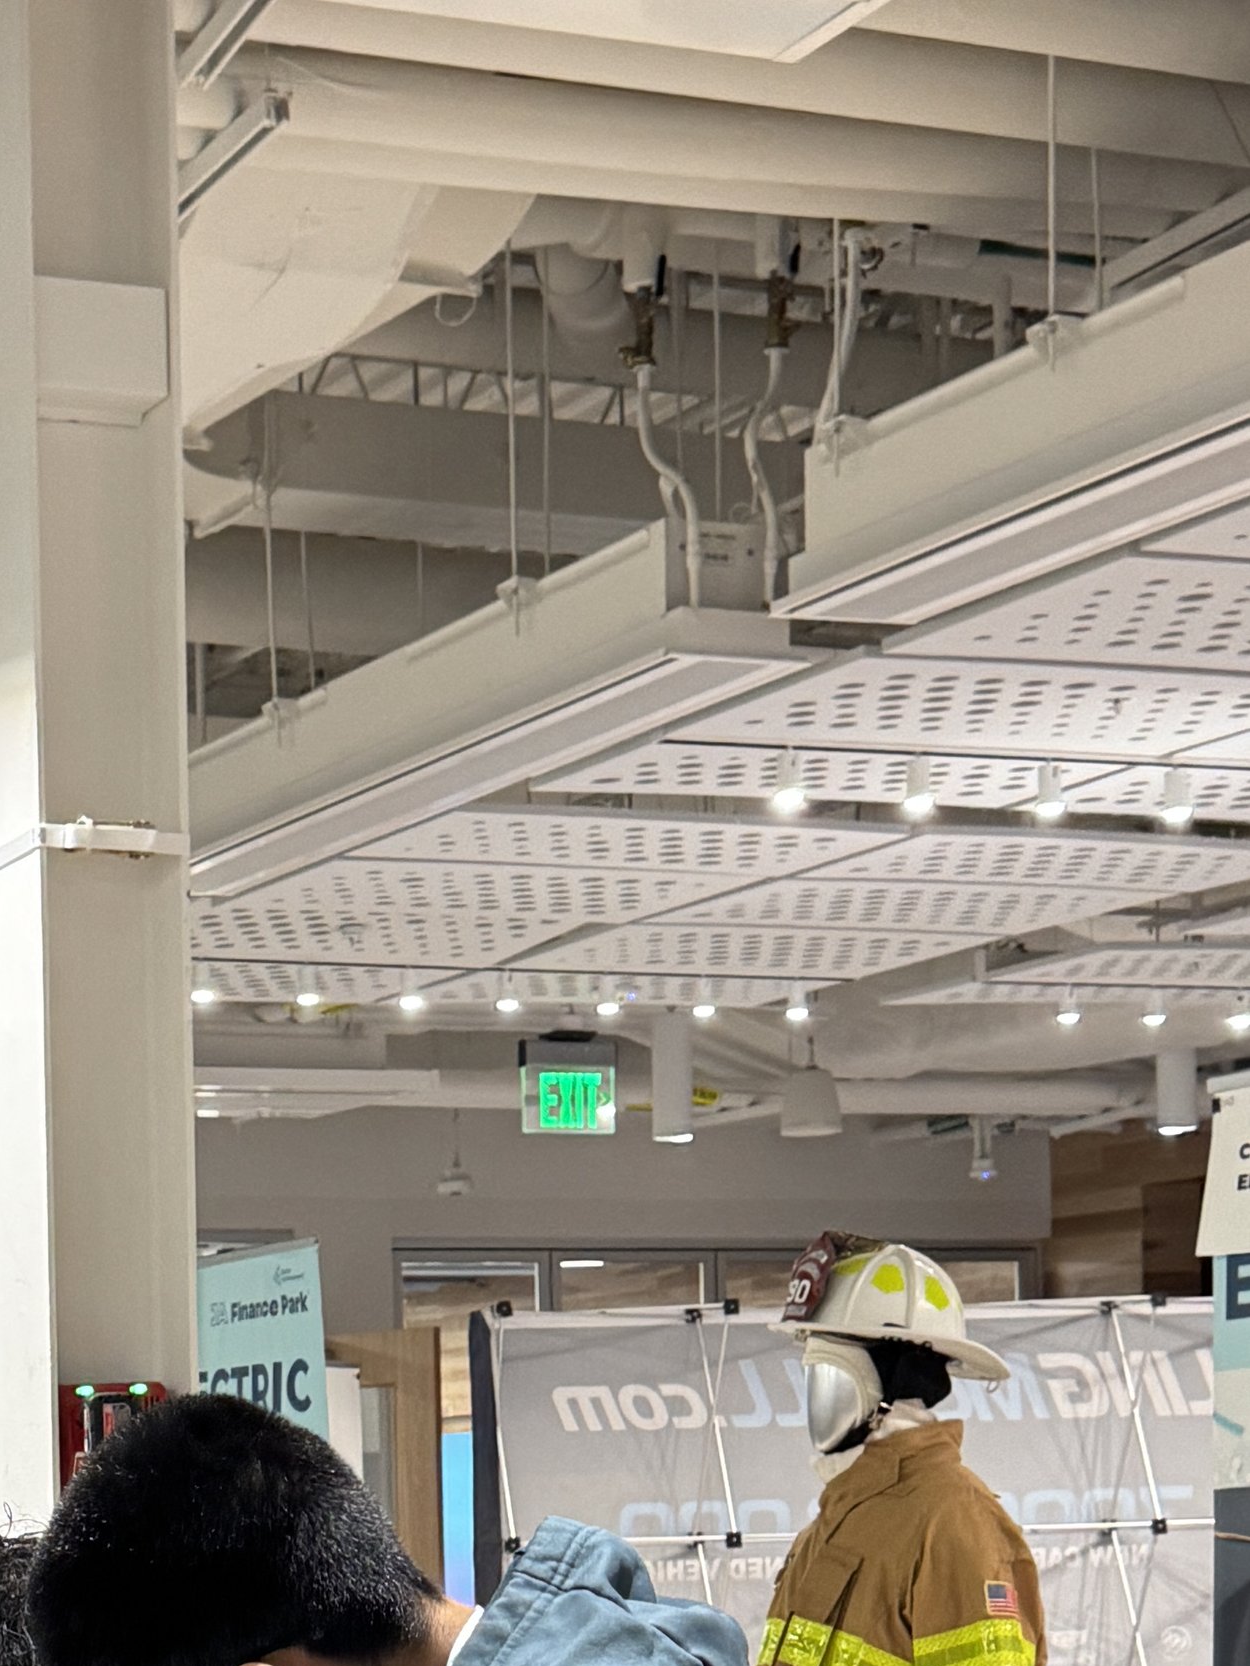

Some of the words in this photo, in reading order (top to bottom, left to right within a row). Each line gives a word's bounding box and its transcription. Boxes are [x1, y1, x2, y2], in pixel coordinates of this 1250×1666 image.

[539, 1072, 602, 1129] EXIT
[231, 1299, 279, 1323] Finance
[281, 1291, 309, 1315] Park
